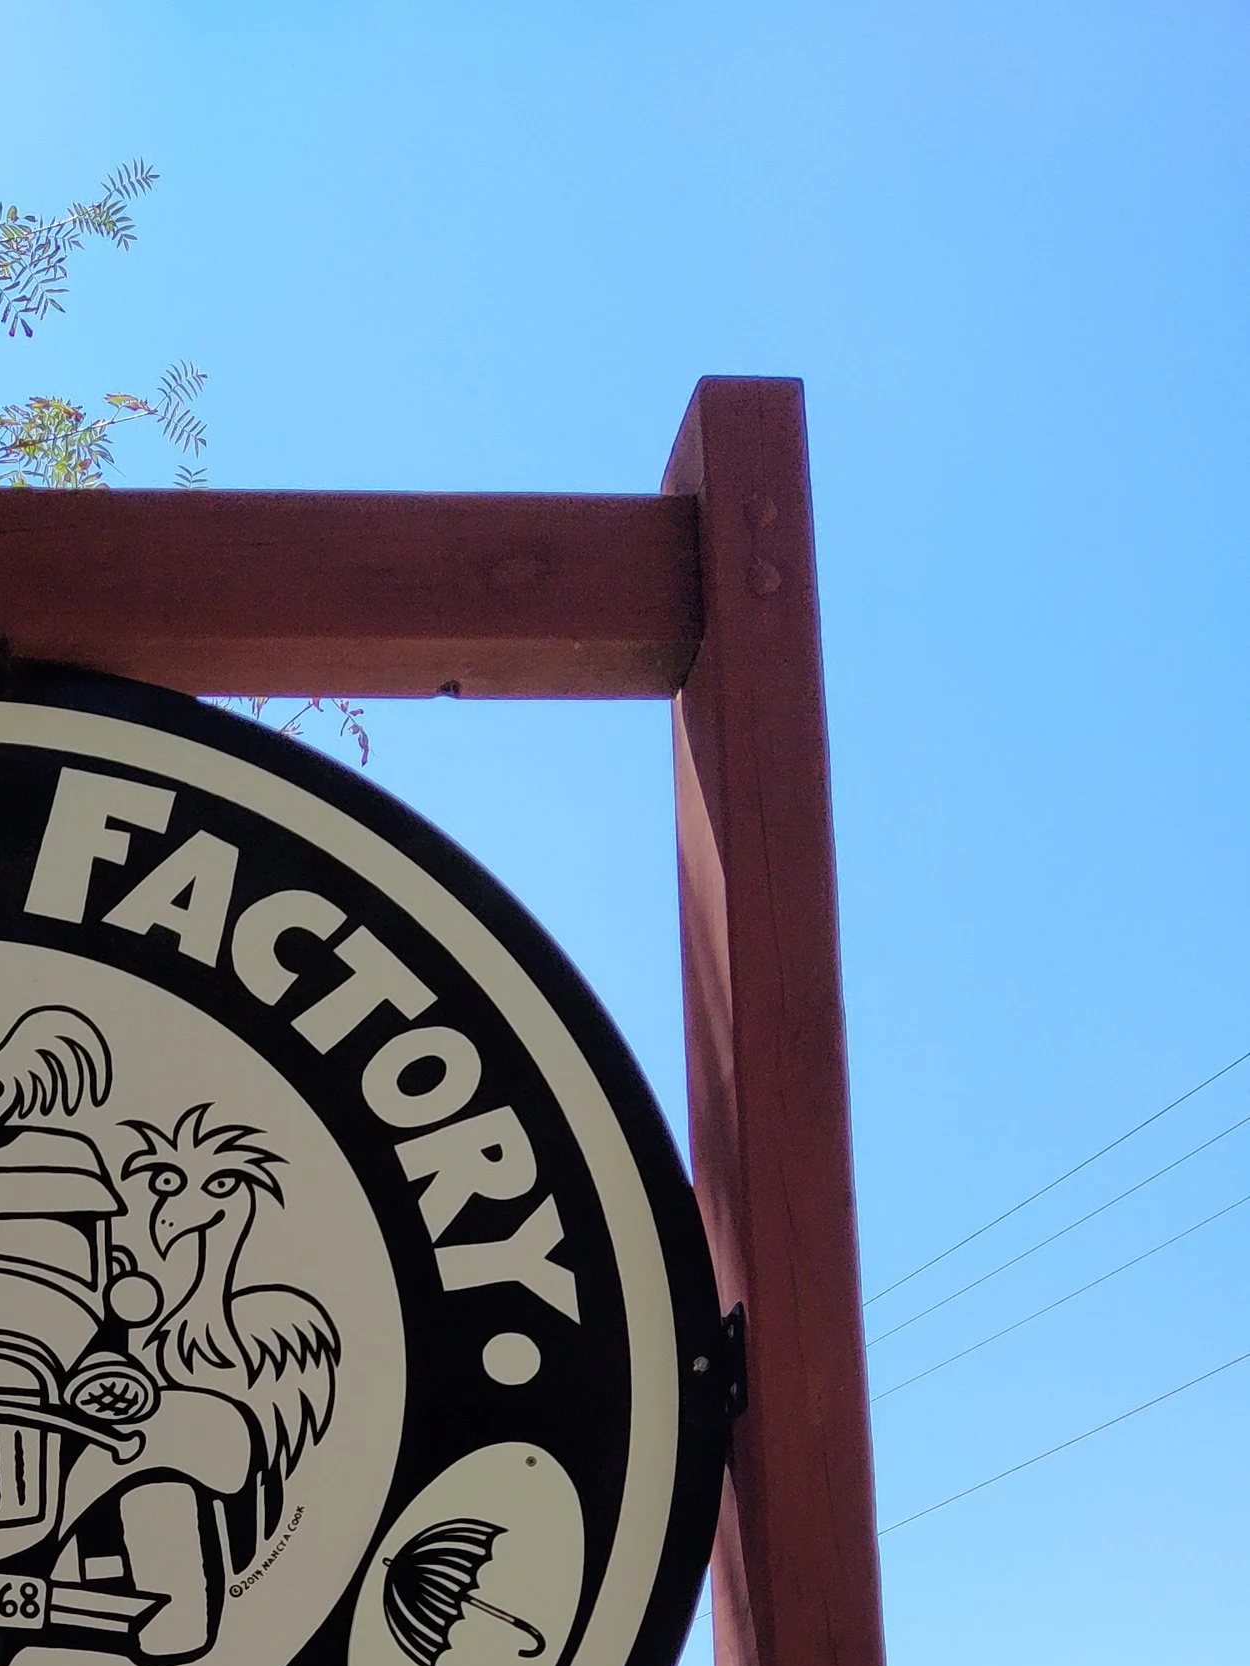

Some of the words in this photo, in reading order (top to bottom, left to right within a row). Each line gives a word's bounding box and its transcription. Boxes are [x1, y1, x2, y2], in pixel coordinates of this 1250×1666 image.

[24, 767, 580, 1324] FACTORY
[261, 1539, 288, 1572] NANCY
[282, 1534, 292, 1543] A
